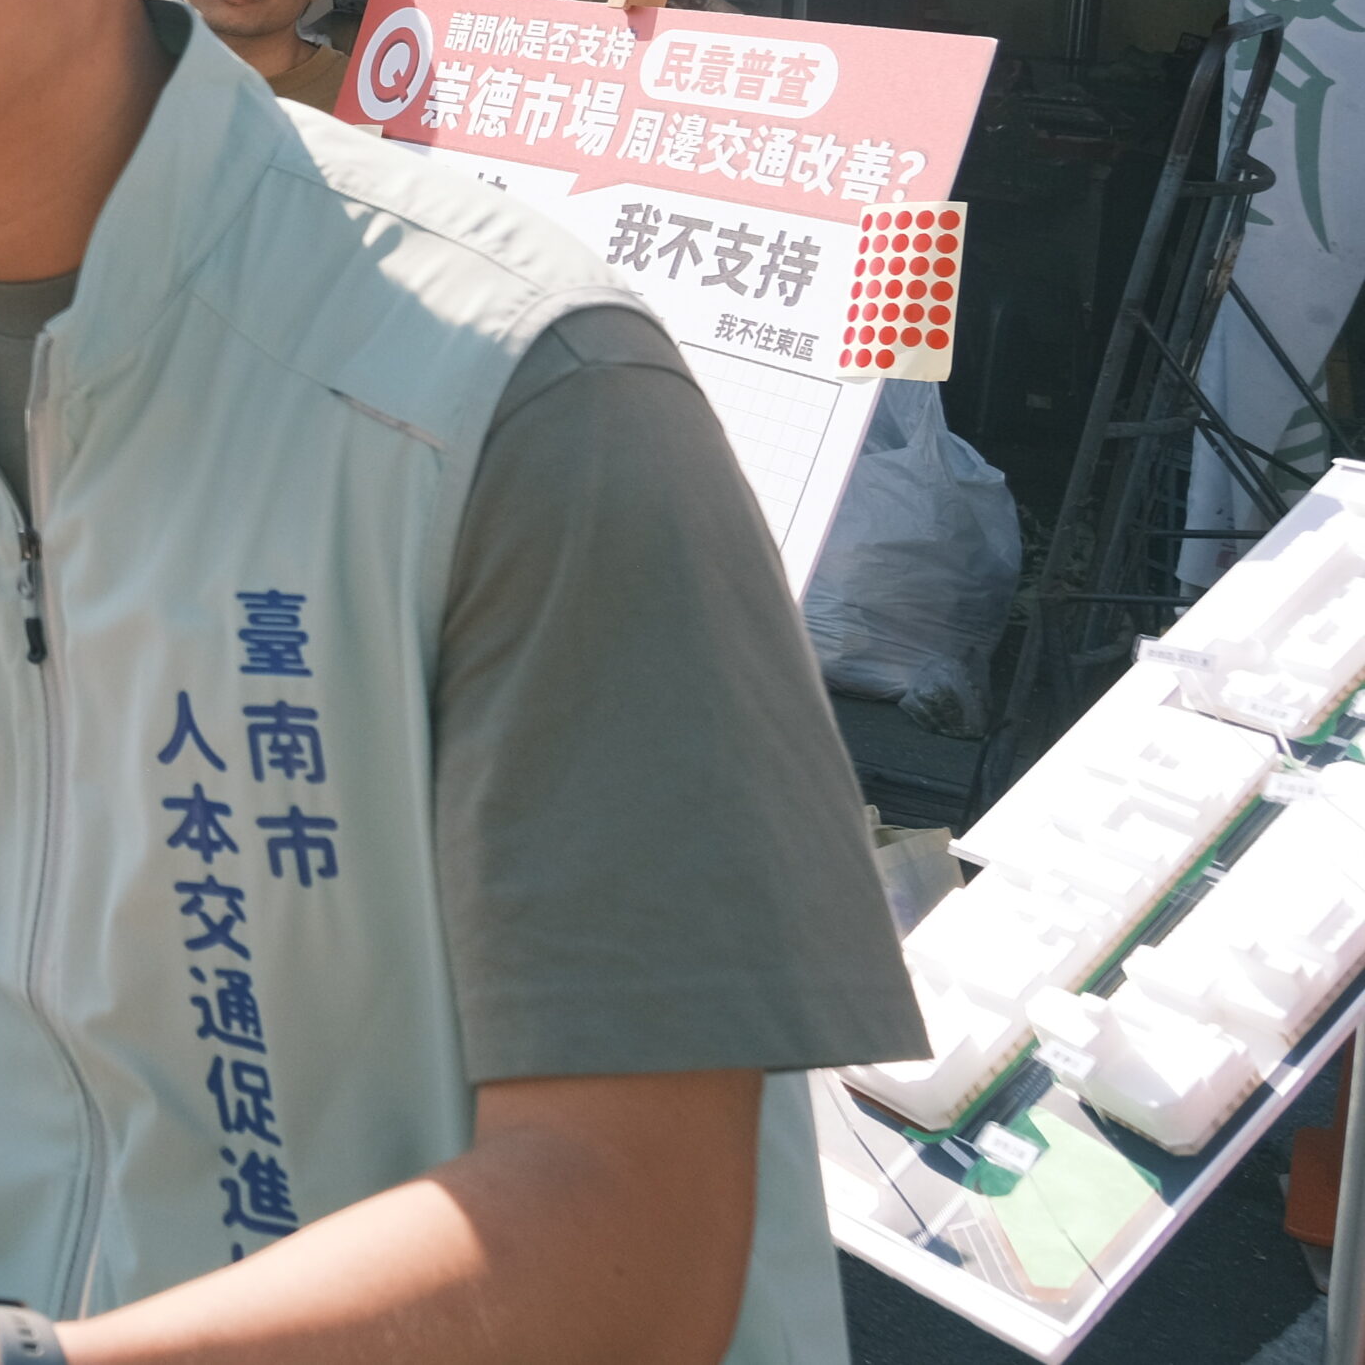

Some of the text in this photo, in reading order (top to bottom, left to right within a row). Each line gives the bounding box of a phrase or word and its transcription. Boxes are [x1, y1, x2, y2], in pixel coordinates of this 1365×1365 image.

[370, 26, 421, 105] Q
[443, 11, 637, 71] 請問你是否支持
[653, 40, 821, 109] 民意普查
[420, 60, 626, 158] 崇德市場
[605, 202, 822, 308] 我不支持
[714, 312, 820, 363] 我不住東區
[235, 588, 339, 889] 臺南市
[155, 689, 301, 1266] 人本交通促進
